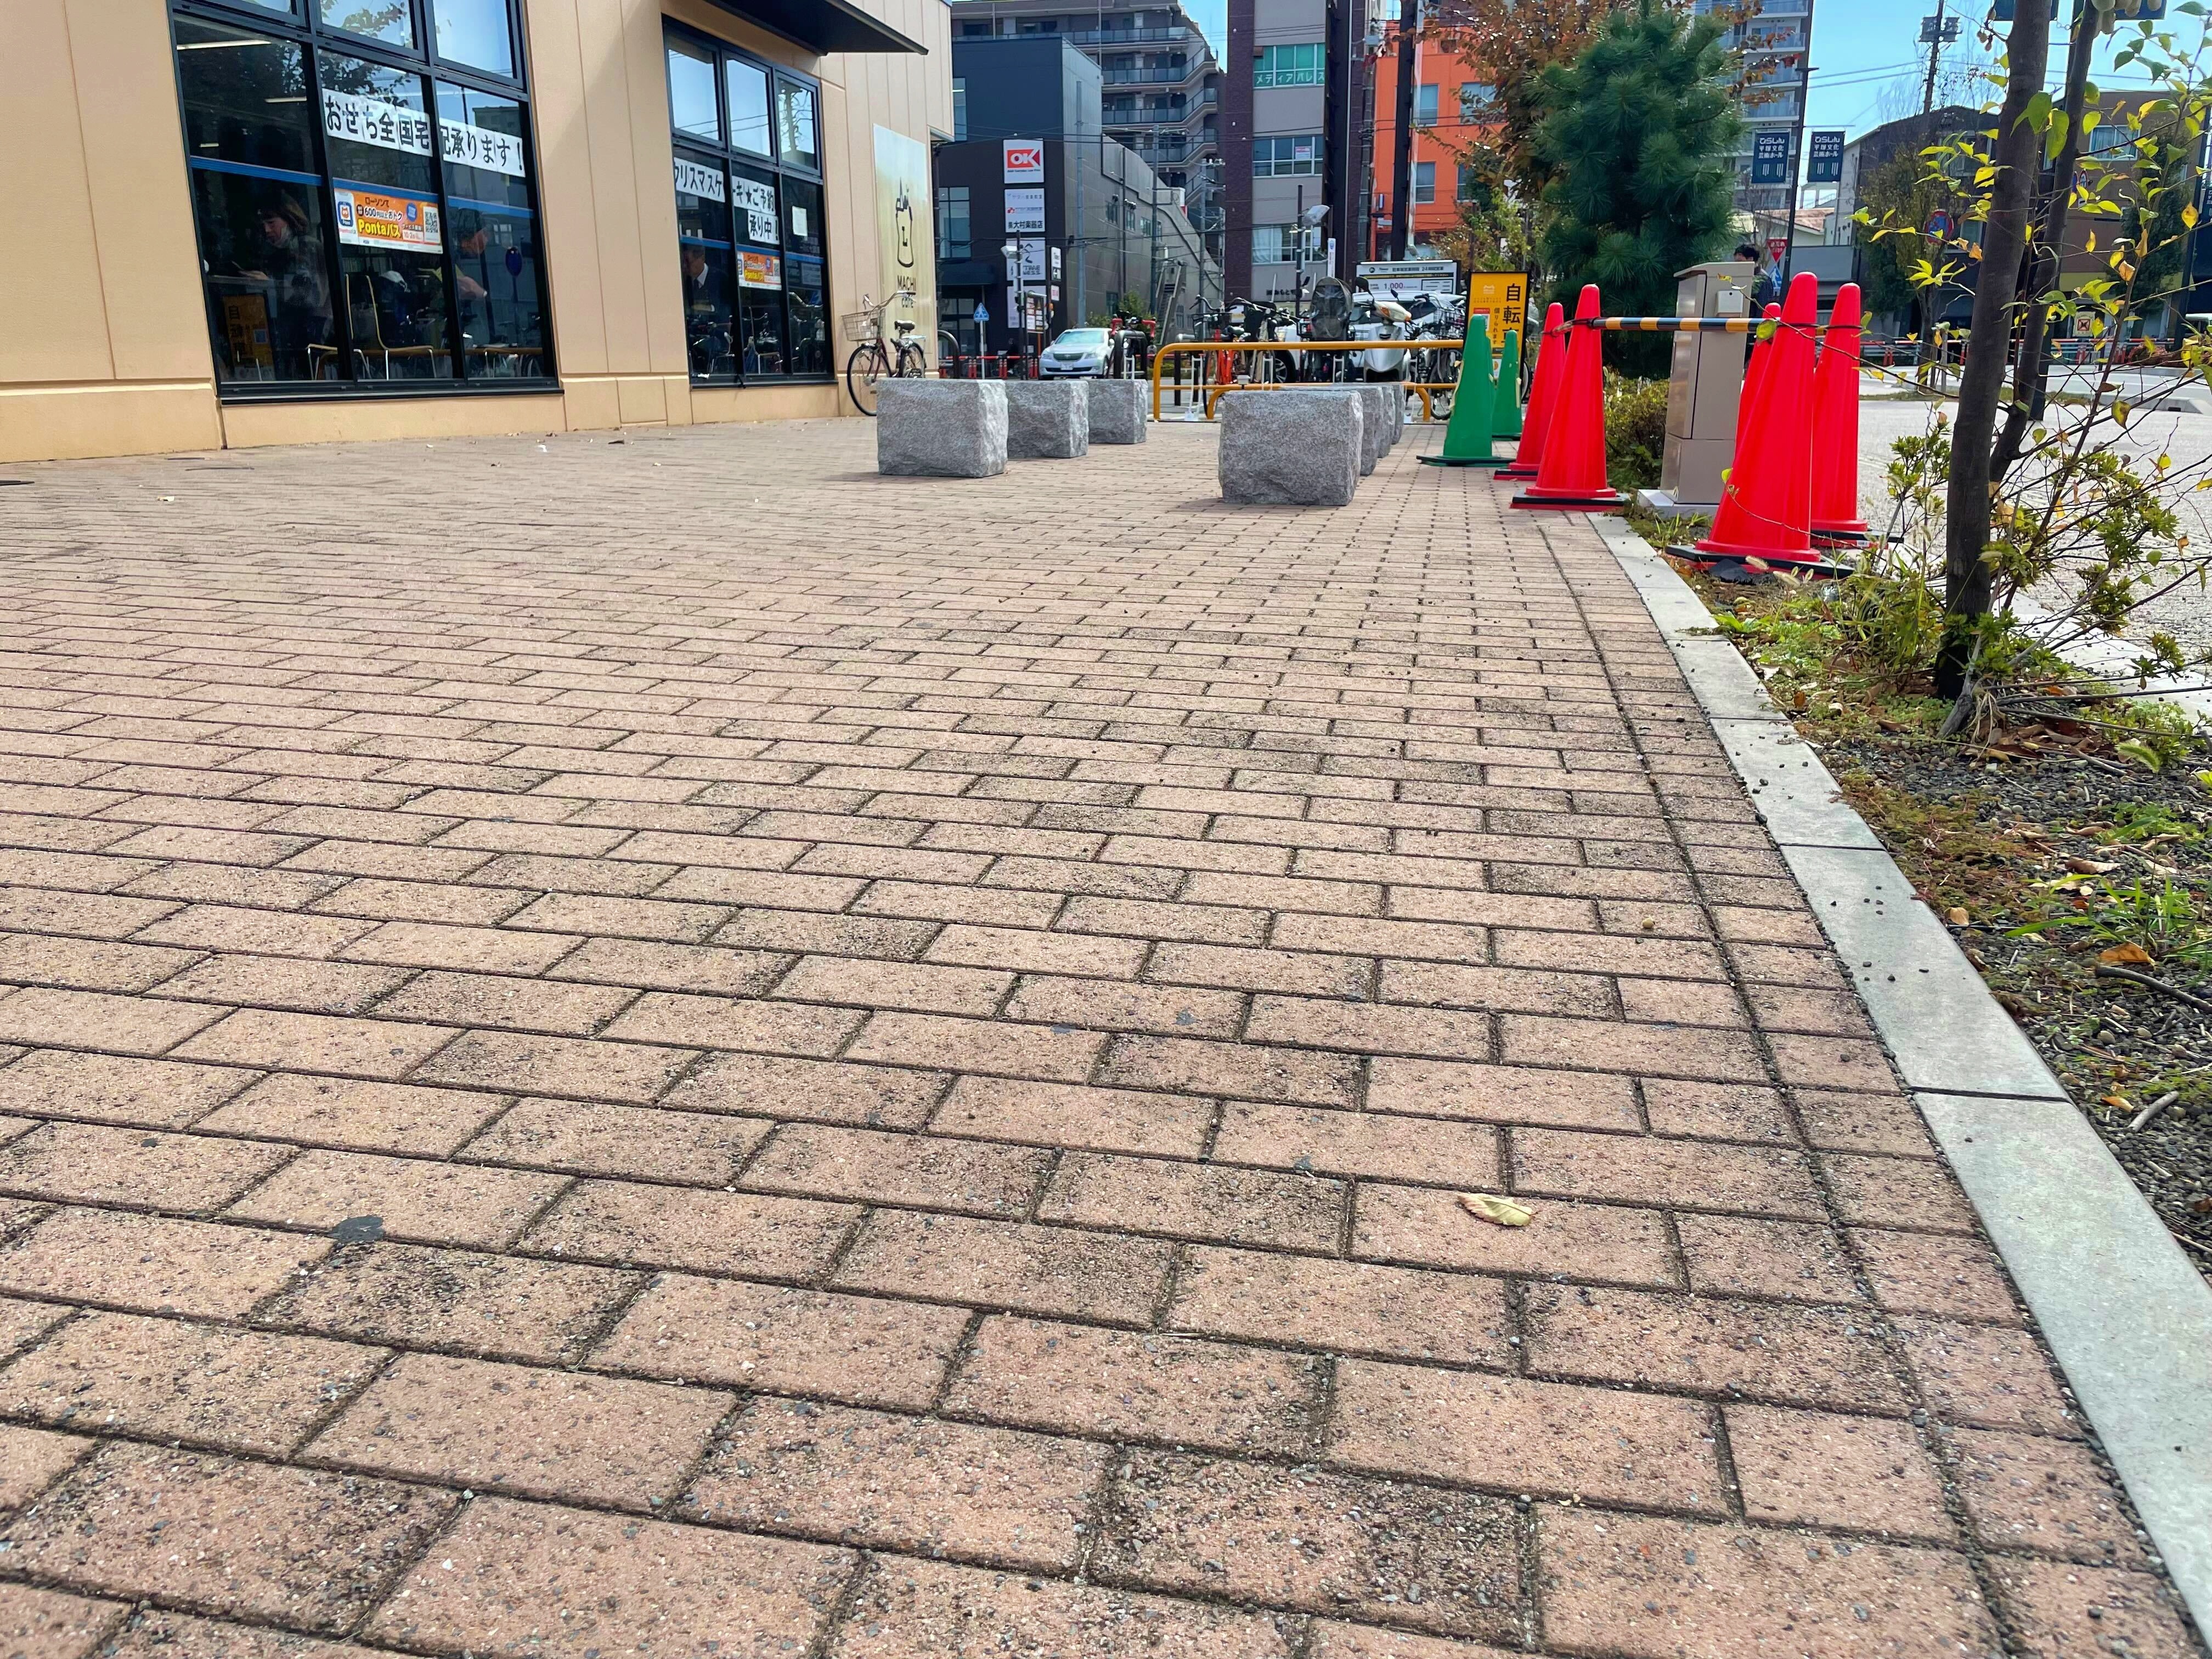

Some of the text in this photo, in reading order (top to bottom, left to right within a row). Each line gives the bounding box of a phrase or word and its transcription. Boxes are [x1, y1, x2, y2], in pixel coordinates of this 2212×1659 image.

[325, 94, 429, 150] おせち全国宅
[1011, 149, 1040, 166] OK
[358, 218, 401, 238] Pontaパス
